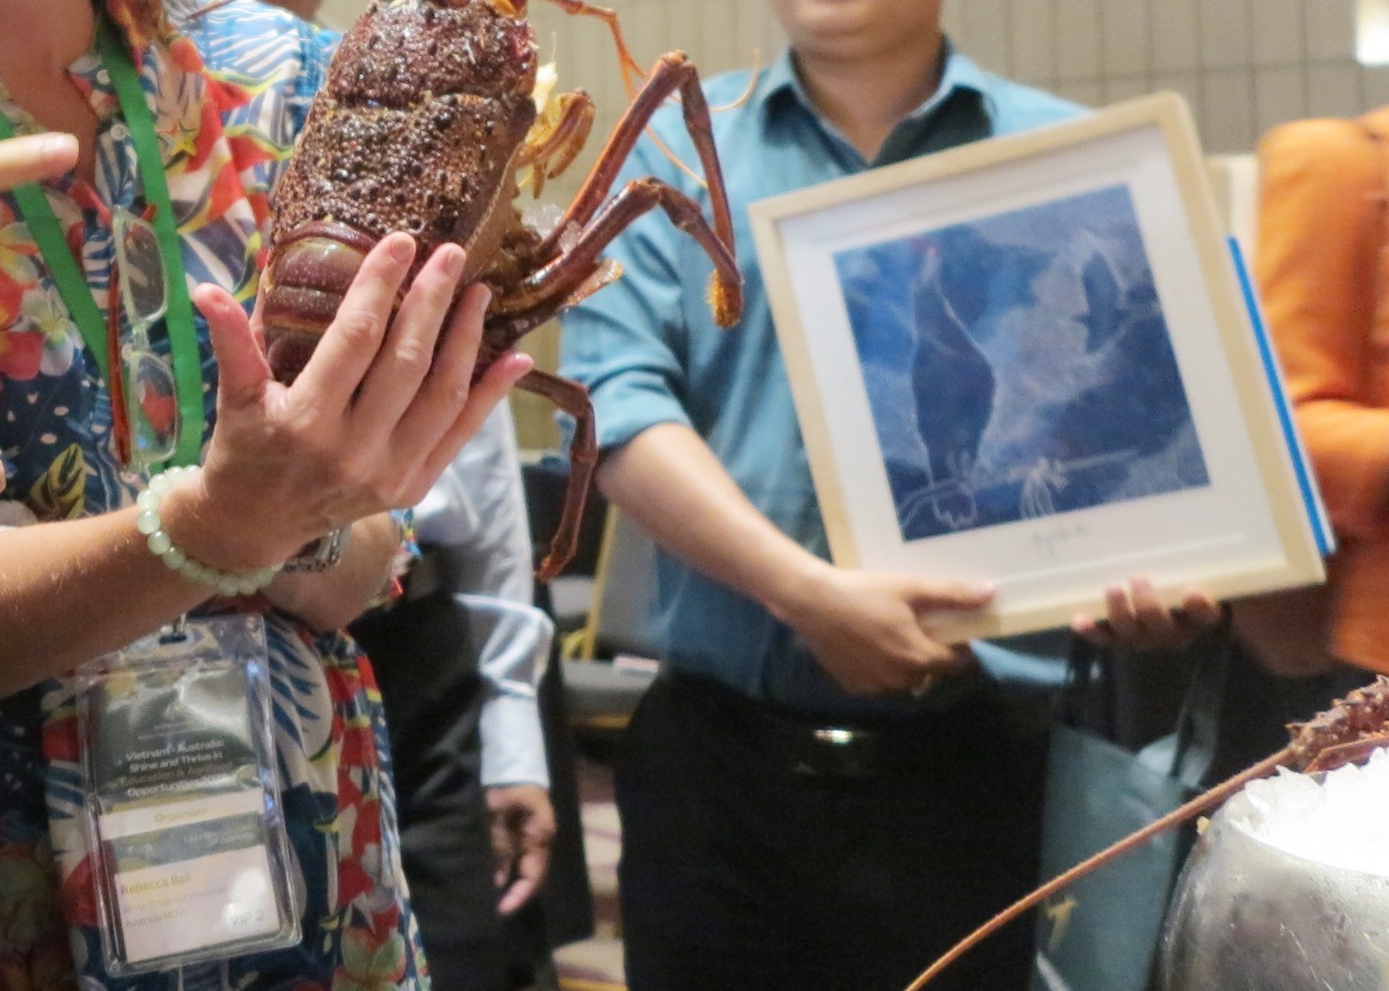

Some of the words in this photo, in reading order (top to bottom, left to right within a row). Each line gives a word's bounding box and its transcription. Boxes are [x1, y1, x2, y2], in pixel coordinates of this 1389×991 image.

[126, 748, 171, 762] Vietnam
[129, 761, 158, 773] Shine
[160, 758, 179, 768] and
[181, 752, 212, 764] Thrive
[121, 878, 169, 895] Rebecca
